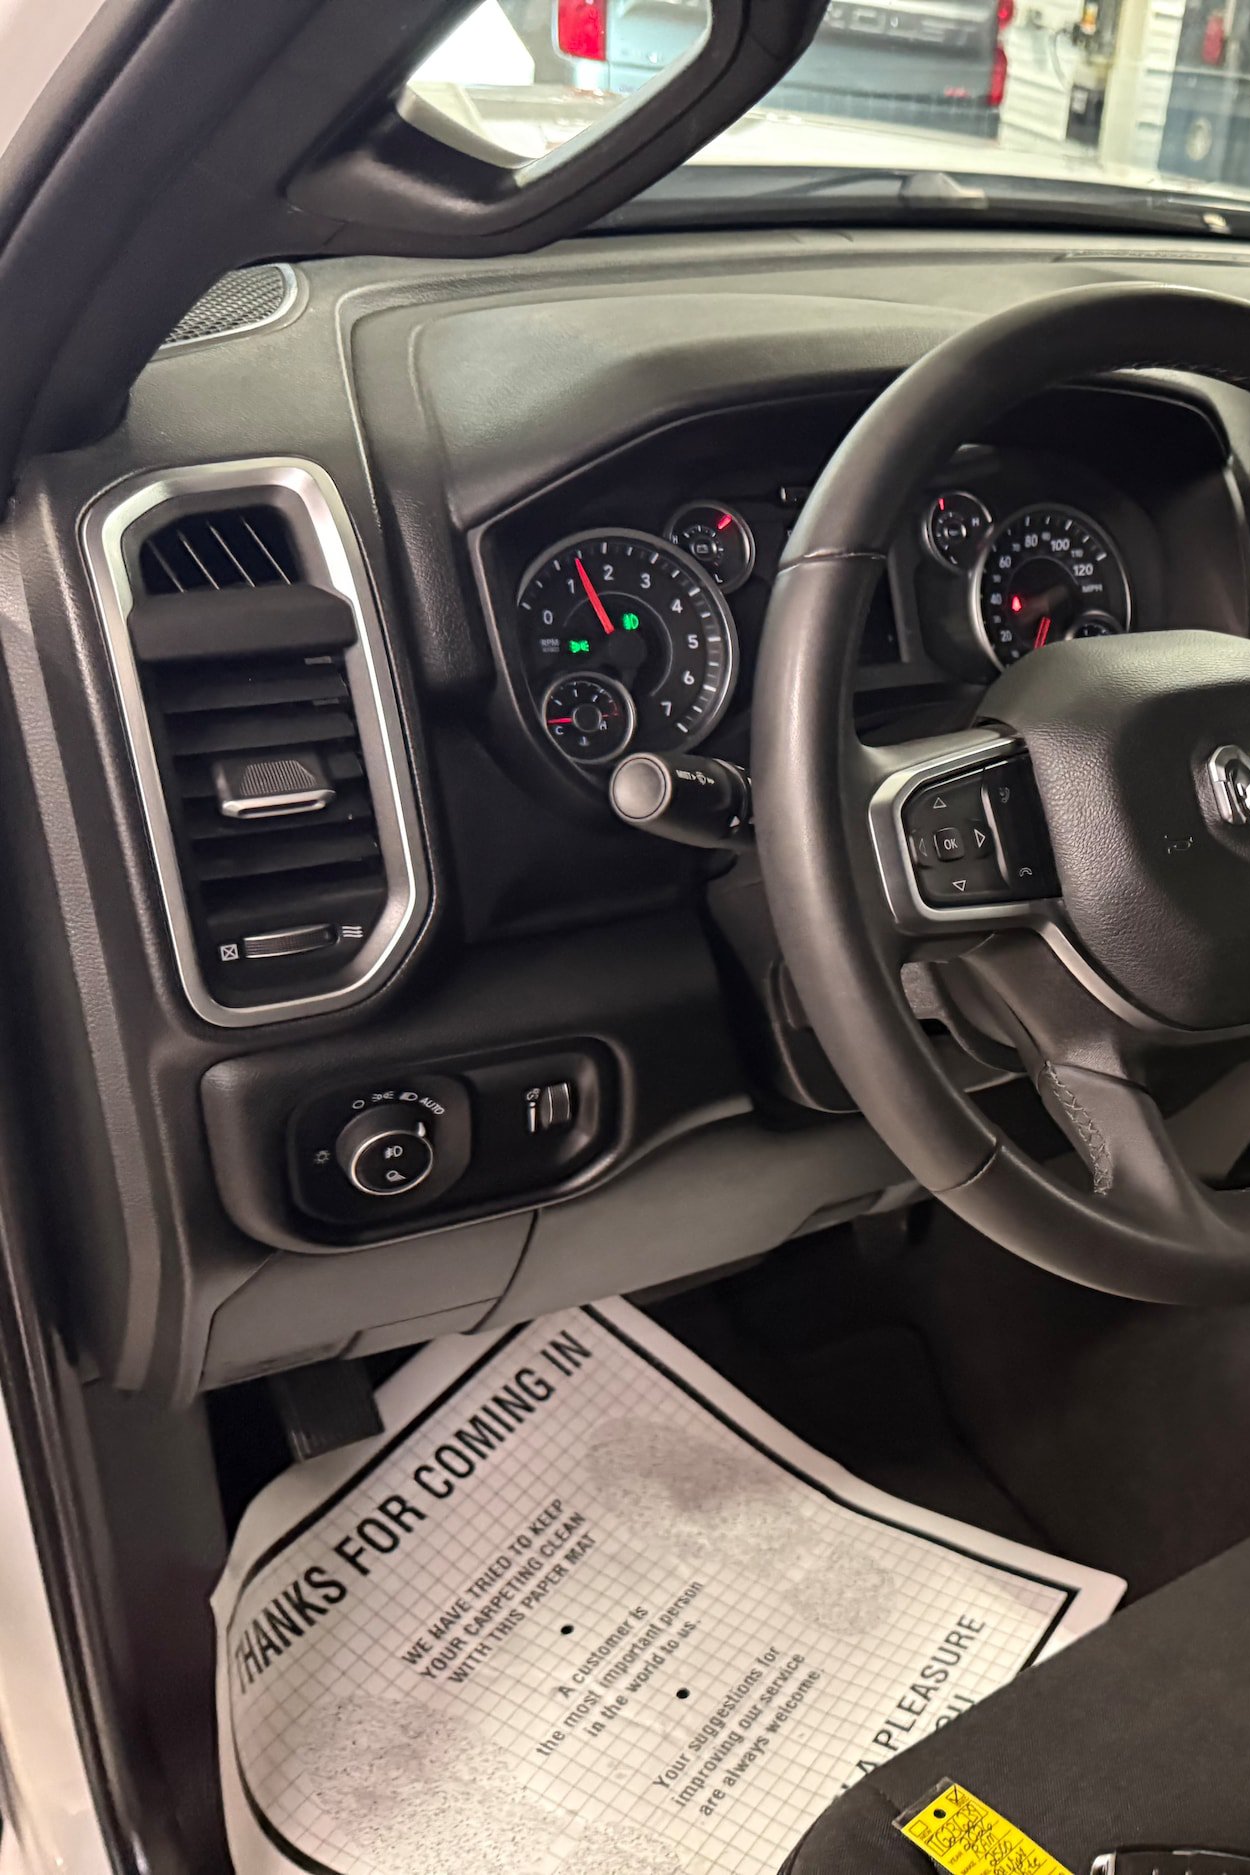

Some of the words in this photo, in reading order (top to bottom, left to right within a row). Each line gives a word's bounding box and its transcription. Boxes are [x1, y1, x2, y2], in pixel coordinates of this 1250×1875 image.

[1024, 534, 1039, 548] 80
[1051, 538, 1071, 552] 100
[999, 555, 1012, 568] 60
[603, 565, 615, 580] 2
[1073, 563, 1094, 576] 120
[567, 578, 575, 594] 1
[640, 573, 651, 588] 3
[671, 599, 683, 614] 4
[543, 611, 553, 625] 0
[688, 635, 699, 649] 5
[1000, 630, 1012, 642] 20
[683, 670, 695, 685] 6
[661, 701, 672, 716] 7
[943, 838, 958, 850] OK
[420, 1097, 445, 1115] AUTO
[235, 1566, 347, 1694] THANKS
[334, 1495, 428, 1577] FOR
[413, 1367, 556, 1499] COMING
[540, 1330, 593, 1377] IN
[401, 1637, 433, 1665] WE
[427, 1598, 472, 1640] HAVE
[465, 1555, 513, 1600] TRIED
[508, 1534, 533, 1555] TO
[528, 1498, 564, 1536] KEEP
[420, 1636, 467, 1680] YOUR
[463, 1556, 544, 1636] CARPETING
[539, 1511, 587, 1558] CLEAN
[447, 1642, 493, 1684] WITH
[488, 1608, 525, 1643] THIS
[521, 1563, 569, 1610] PAPER
[564, 1532, 597, 1565] MAT
[558, 1684, 576, 1699] A
[571, 1617, 636, 1685] customer
[535, 1730, 566, 1756] the
[563, 1689, 602, 1728] most
[599, 1623, 663, 1688] important
[658, 1580, 704, 1627] person
[584, 1721, 606, 1738] in
[600, 1693, 629, 1720] the
[625, 1652, 666, 1693] world
[659, 1638, 680, 1656] to
[872, 1613, 986, 1751] PLEASURE
[652, 1752, 691, 1790] Your
[688, 1668, 763, 1753] suggestions
[756, 1645, 781, 1668] for
[671, 1730, 745, 1808] improving
[738, 1704, 763, 1731] our
[760, 1653, 806, 1704] service
[699, 1787, 727, 1817] are
[723, 1734, 770, 1788] always
